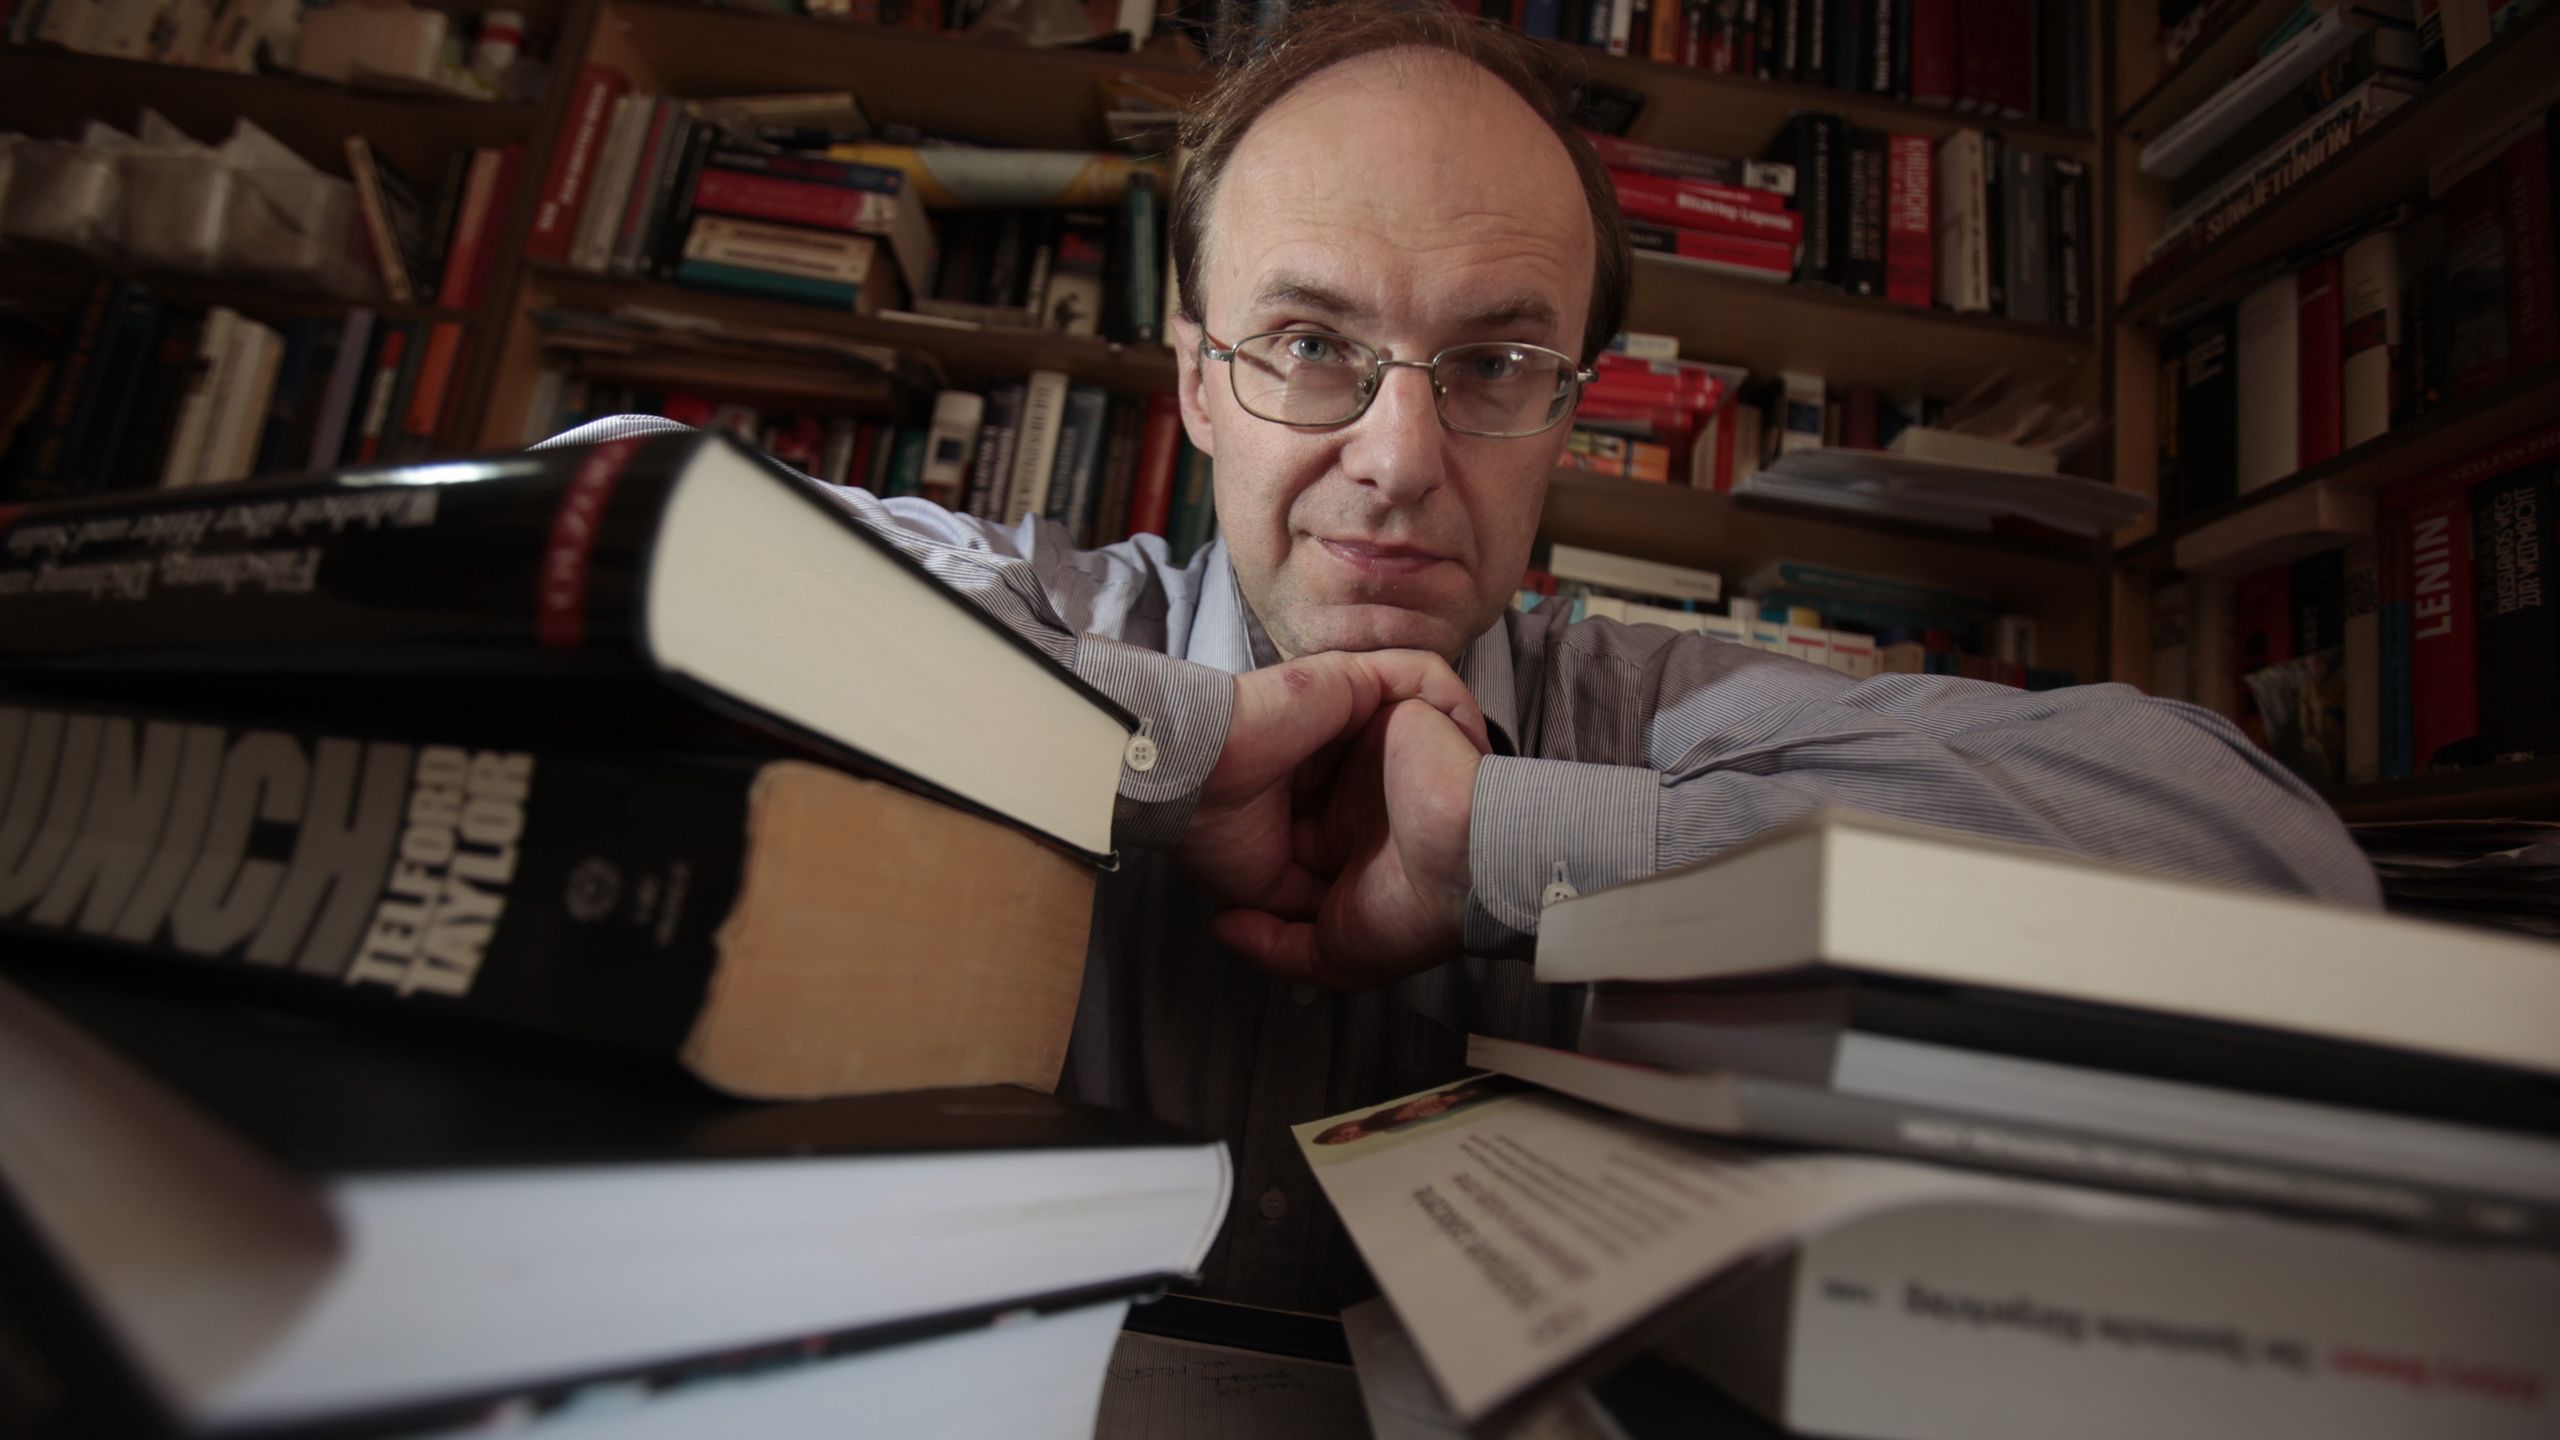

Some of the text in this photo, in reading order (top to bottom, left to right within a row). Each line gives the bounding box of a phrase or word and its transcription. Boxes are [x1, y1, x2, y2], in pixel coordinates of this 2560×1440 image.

[2413, 515, 2451, 640] LENIN
[2493, 491, 2517, 615] RUSSLANDS WEG
[2513, 487, 2542, 610] ZUR WELTMACHT
[0, 704, 412, 978] UNICH
[344, 743, 473, 988] TELFORD
[397, 749, 538, 1000] TAYLOR
